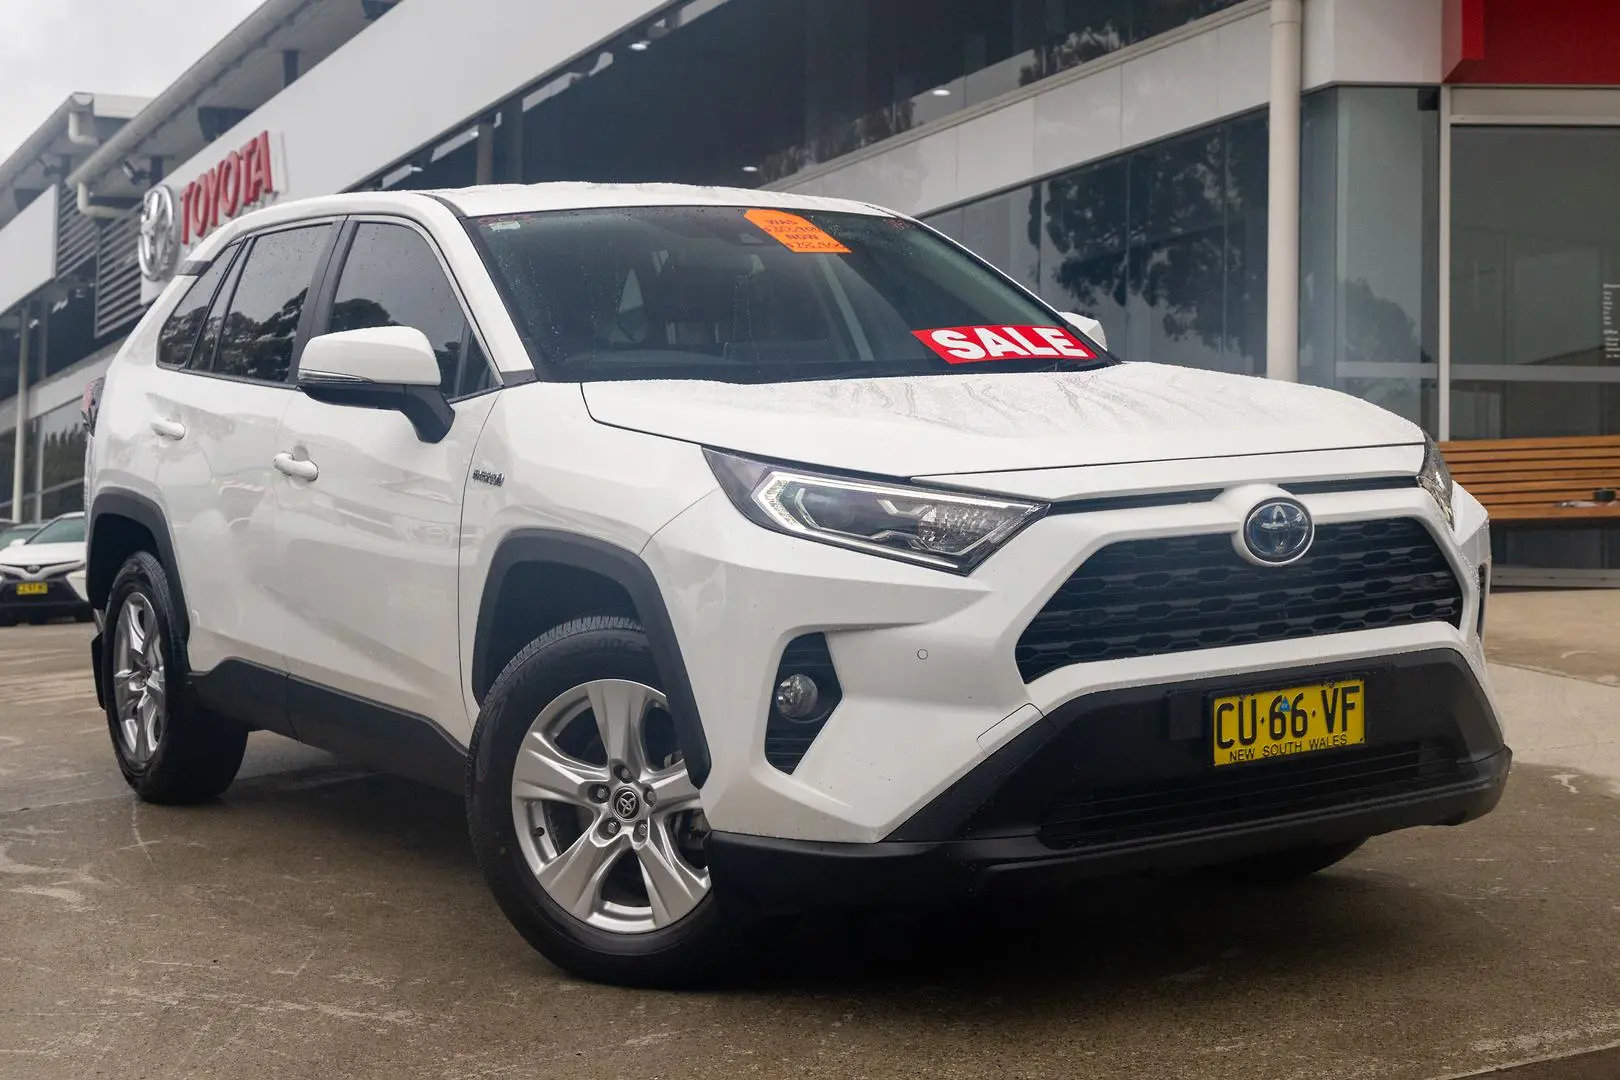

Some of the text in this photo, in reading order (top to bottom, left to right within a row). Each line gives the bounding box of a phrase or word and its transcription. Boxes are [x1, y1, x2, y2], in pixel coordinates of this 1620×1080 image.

[180, 130, 273, 245] TOYOTA
[931, 327, 1089, 360] SALE
[1229, 734, 1348, 762] NEW SOUTH WALES
